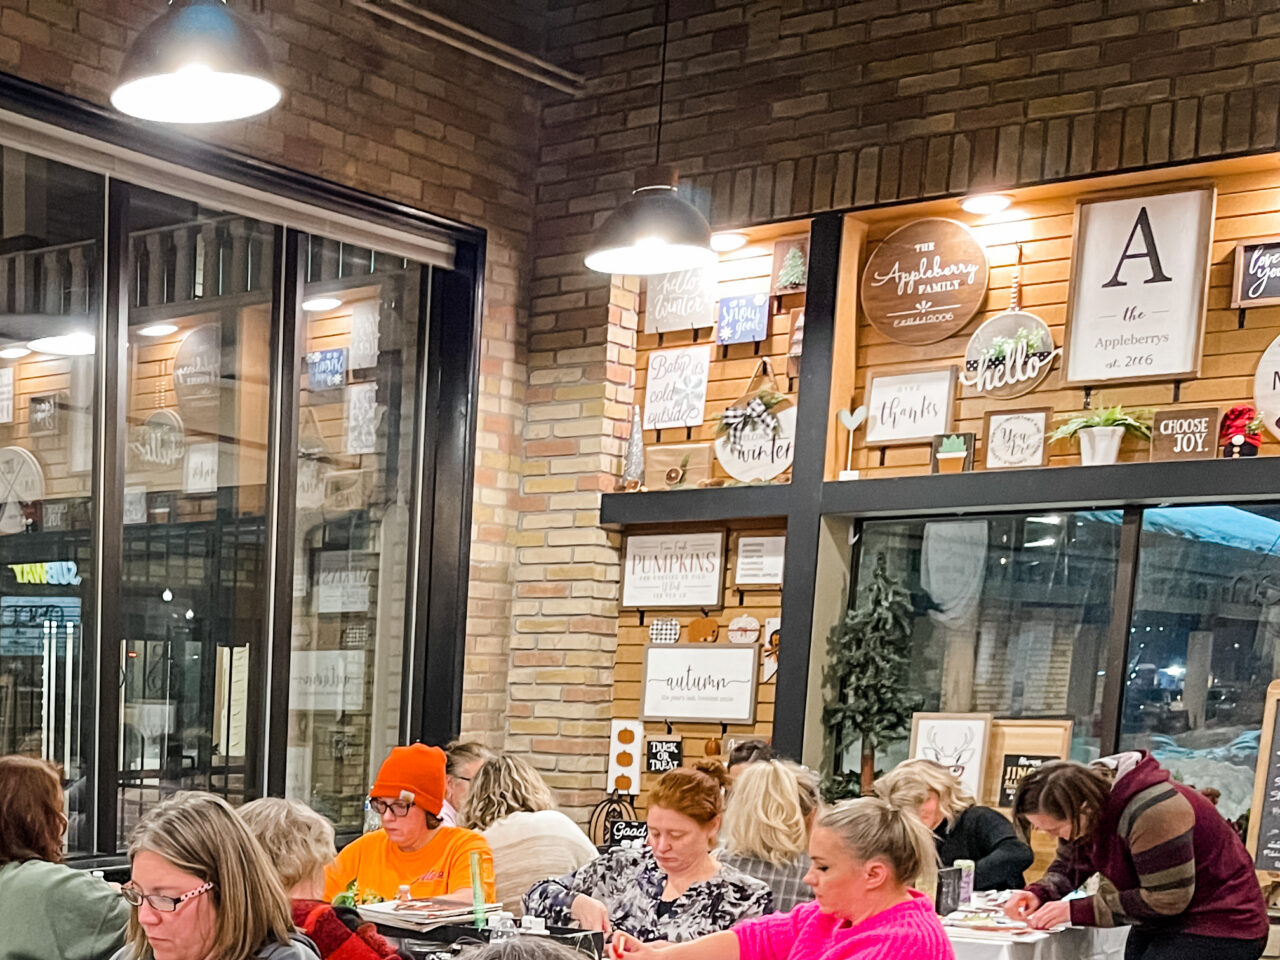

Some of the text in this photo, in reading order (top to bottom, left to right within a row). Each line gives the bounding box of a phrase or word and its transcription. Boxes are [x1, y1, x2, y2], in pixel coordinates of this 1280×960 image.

[914, 242, 935, 252] THE
[1101, 206, 1173, 288] A
[871, 255, 979, 295] Appleberry
[918, 280, 961, 294] FAMILY
[1123, 306, 1146, 322] the
[1094, 333, 1170, 351] Appleberrys
[650, 353, 692, 381] Baby
[958, 337, 1062, 393] hello
[649, 382, 677, 403] cold
[647, 406, 700, 425] outside
[880, 395, 938, 429] thanks
[1160, 418, 1209, 435] CHOOSE
[1173, 434, 1209, 453] JOY.
[631, 551, 716, 576] PUMPKINS
[648, 664, 750, 691] autumn
[650, 741, 678, 754] TRICK
[656, 751, 669, 762] OR
[613, 821, 647, 840] Good
